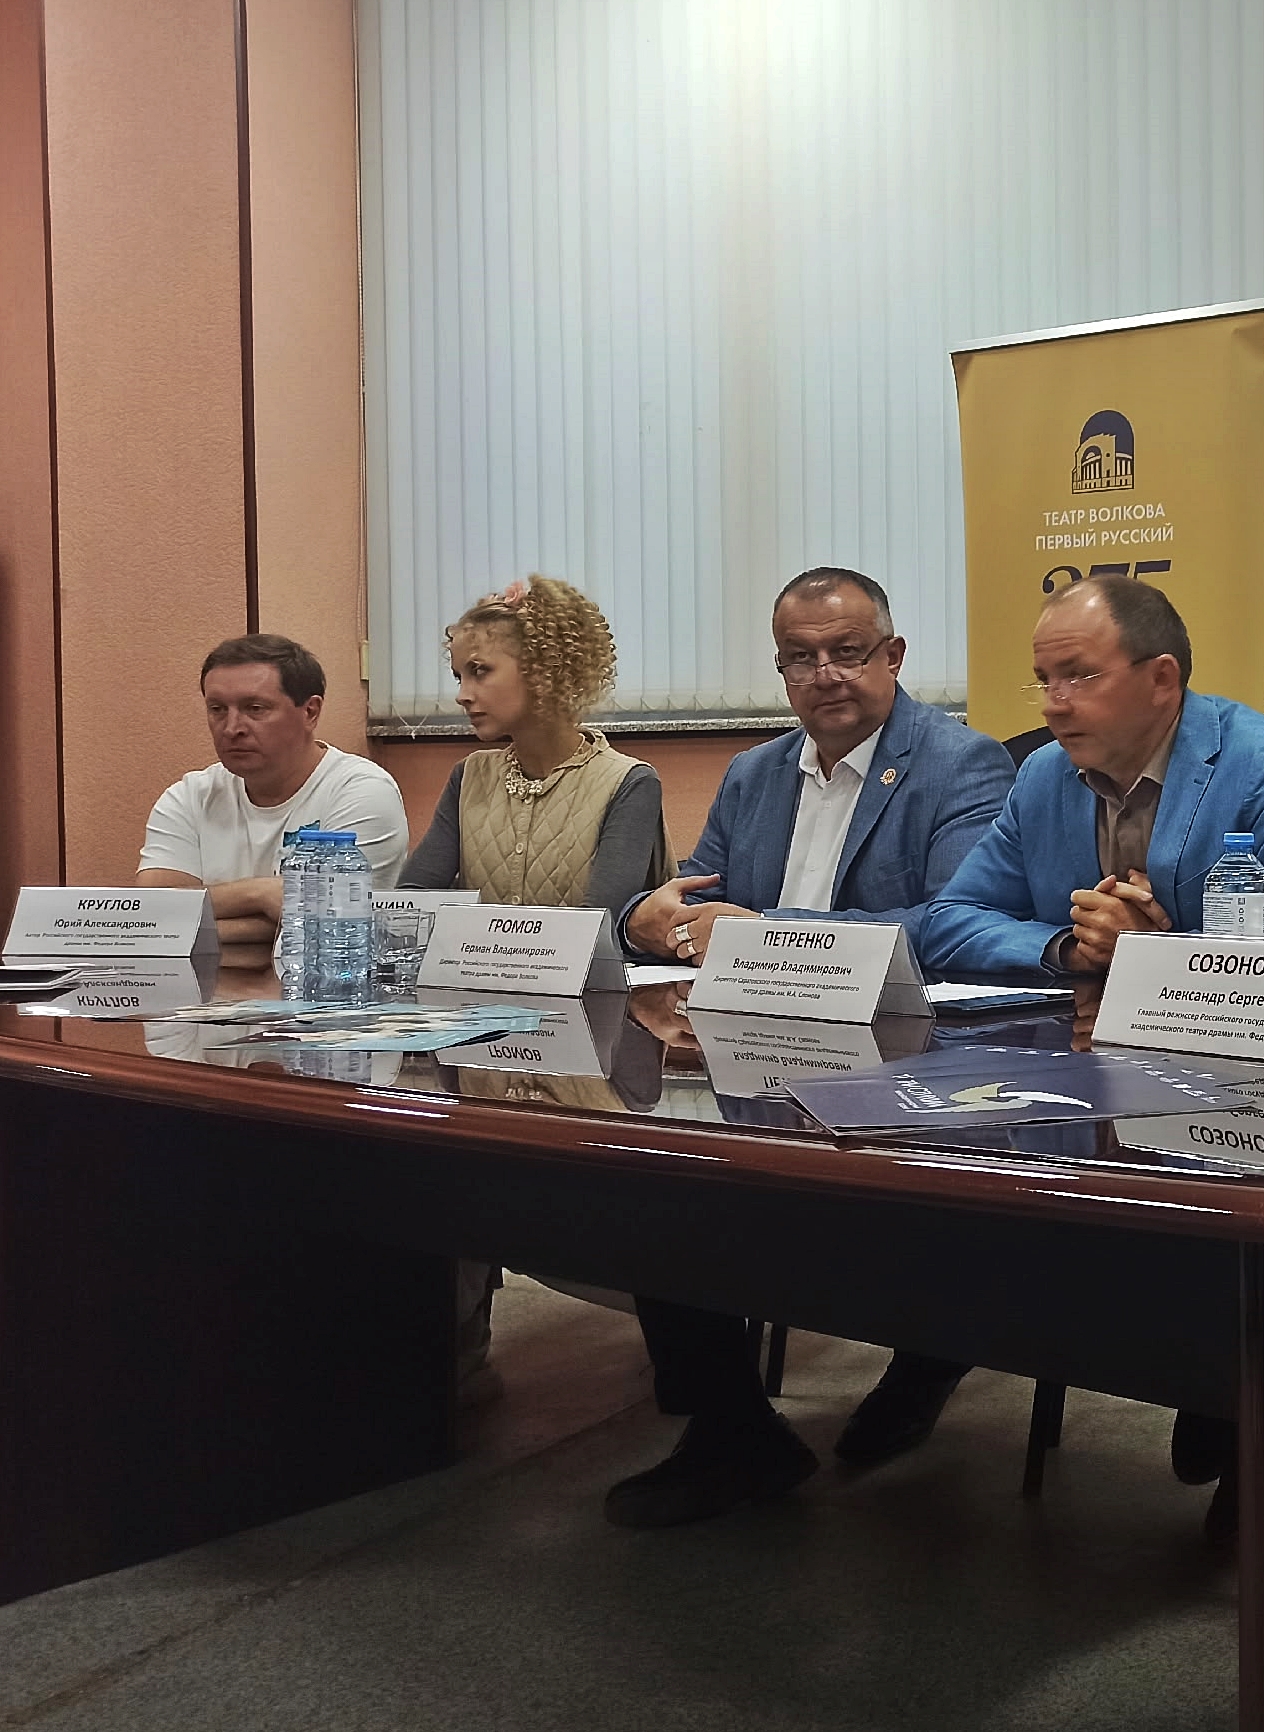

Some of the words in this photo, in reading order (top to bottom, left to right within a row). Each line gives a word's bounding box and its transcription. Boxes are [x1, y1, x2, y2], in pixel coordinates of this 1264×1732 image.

[1043, 509, 1085, 526] ТЕАТР
[1089, 503, 1165, 524] ВОЛКОВА
[1035, 529, 1096, 551] ПЕРВЫЙ
[1101, 523, 1174, 546] РУССКИЙ
[77, 899, 141, 911] КРУГЛОВ
[54, 919, 82, 930] Юрий
[83, 919, 157, 931] Александрович
[488, 918, 543, 935] ГРОМОВ
[763, 930, 836, 950] ПЕТРЕНКО
[460, 942, 491, 954] Герман
[492, 944, 556, 959] Владимирович
[732, 958, 779, 973] Владимир
[780, 960, 852, 976] Владимирович
[1158, 986, 1226, 1006] Александр
[1137, 1008, 1166, 1019] Главный
[1167, 1010, 1199, 1021] режиссер
[1200, 1012, 1243, 1025] Российского
[1130, 1023, 1184, 1035] академического
[1185, 1026, 1207, 1036] театра
[1208, 1027, 1233, 1039] драмы
[1235, 1031, 1247, 1039] им.
